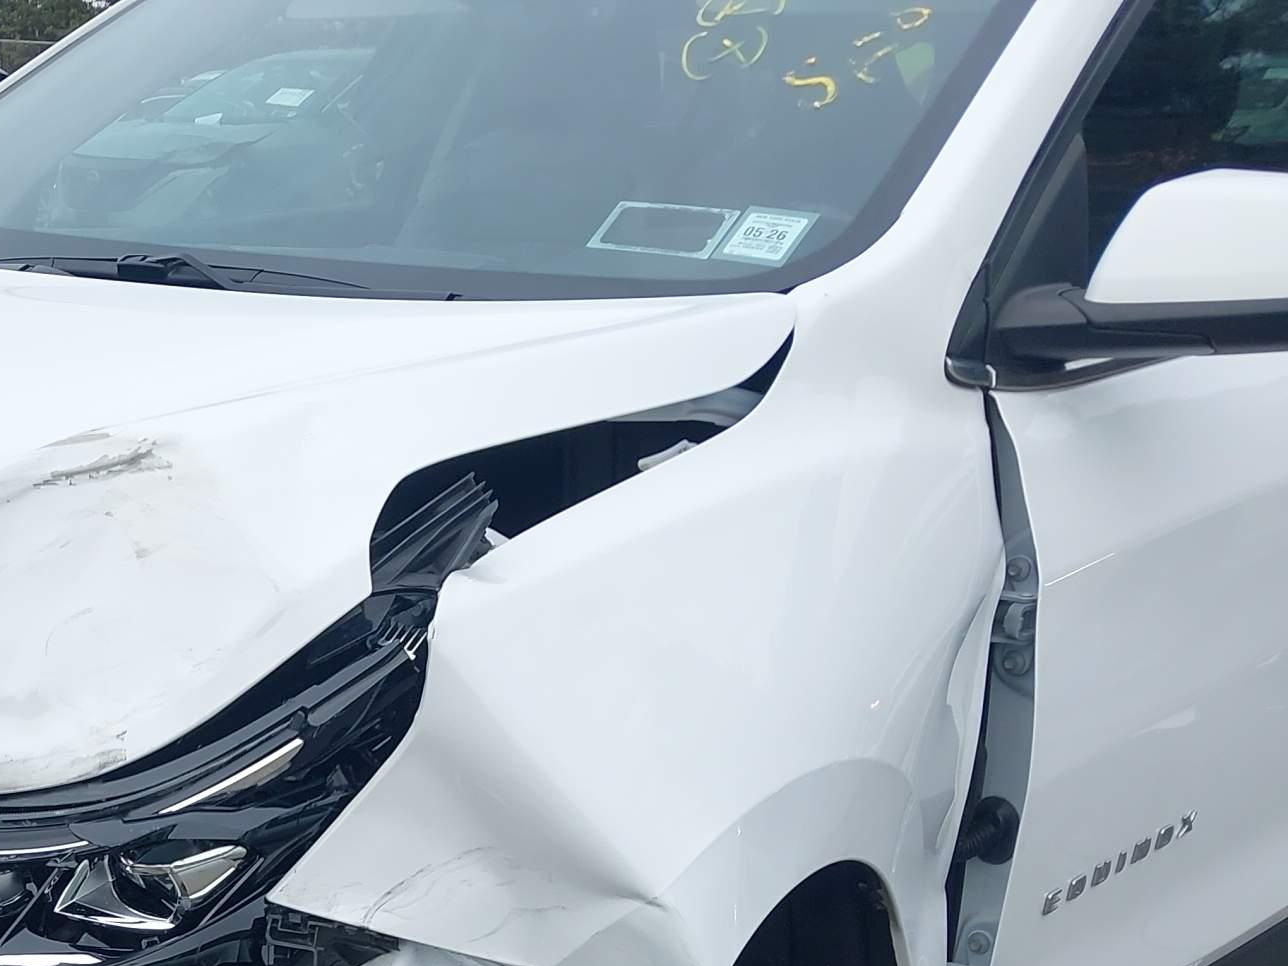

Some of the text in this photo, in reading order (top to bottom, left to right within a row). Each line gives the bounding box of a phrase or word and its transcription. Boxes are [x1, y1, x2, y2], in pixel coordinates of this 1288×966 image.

[743, 226, 789, 241] 05 26
[1041, 808, 1198, 916] EQUINOX
